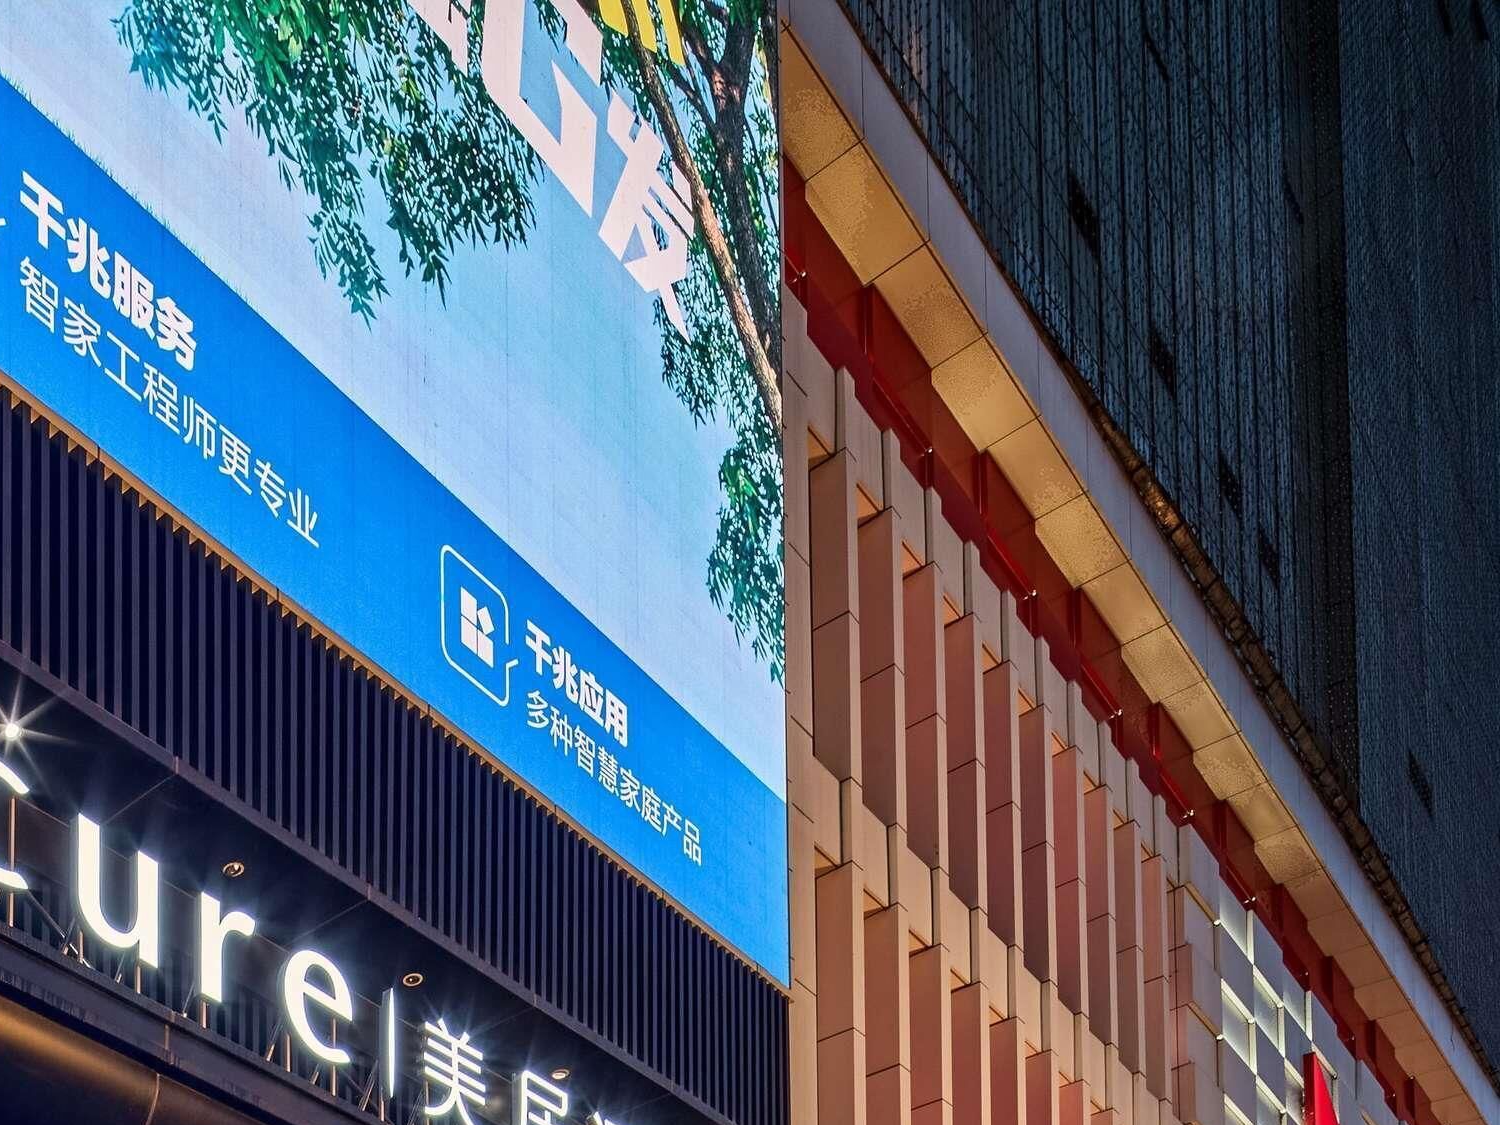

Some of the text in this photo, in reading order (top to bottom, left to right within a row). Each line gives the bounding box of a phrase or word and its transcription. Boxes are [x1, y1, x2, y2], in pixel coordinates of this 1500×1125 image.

[20, 170, 197, 371] 千兆服务
[19, 256, 320, 549] 智家工程师更专业
[525, 619, 628, 748] 千兆应用
[526, 690, 702, 866] 多种智慧家庭产品
